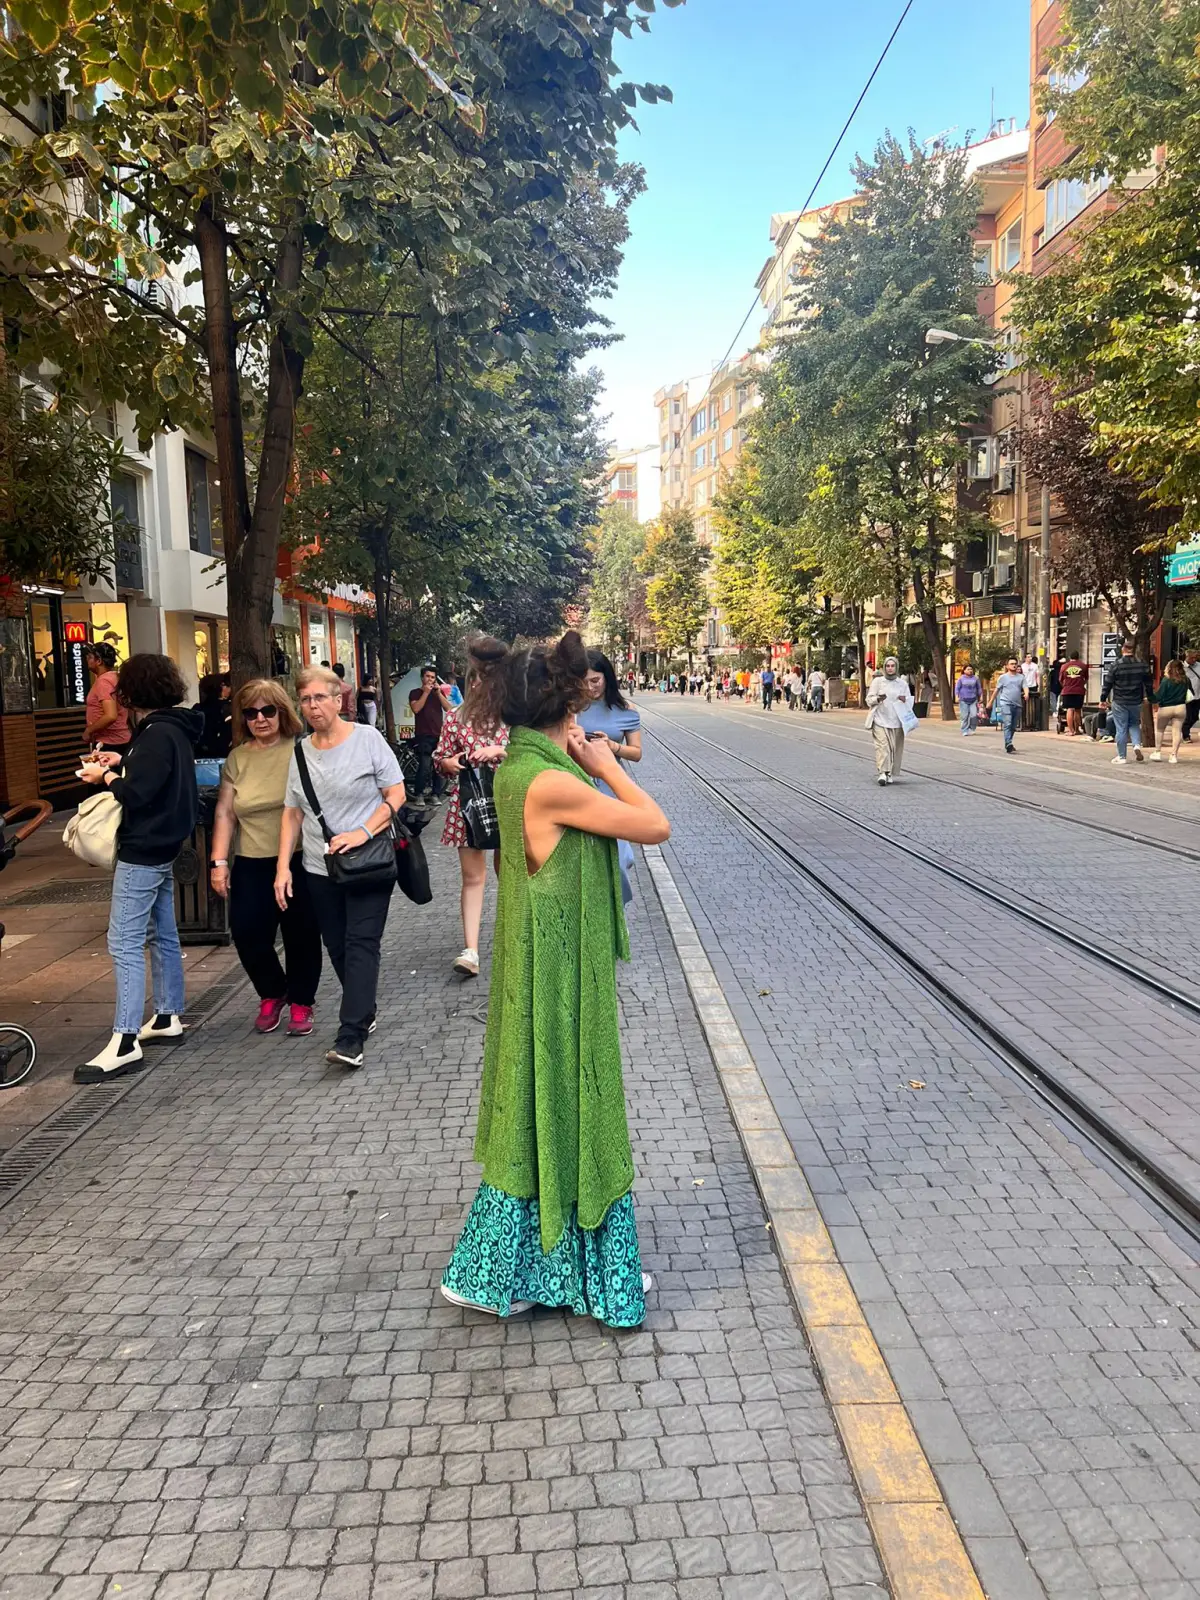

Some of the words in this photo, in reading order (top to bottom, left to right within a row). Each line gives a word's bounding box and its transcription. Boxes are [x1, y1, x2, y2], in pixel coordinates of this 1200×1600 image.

[1066, 592, 1095, 610] STREET
[73, 643, 84, 702] McDonald's
[401, 726, 415, 734] KEN
